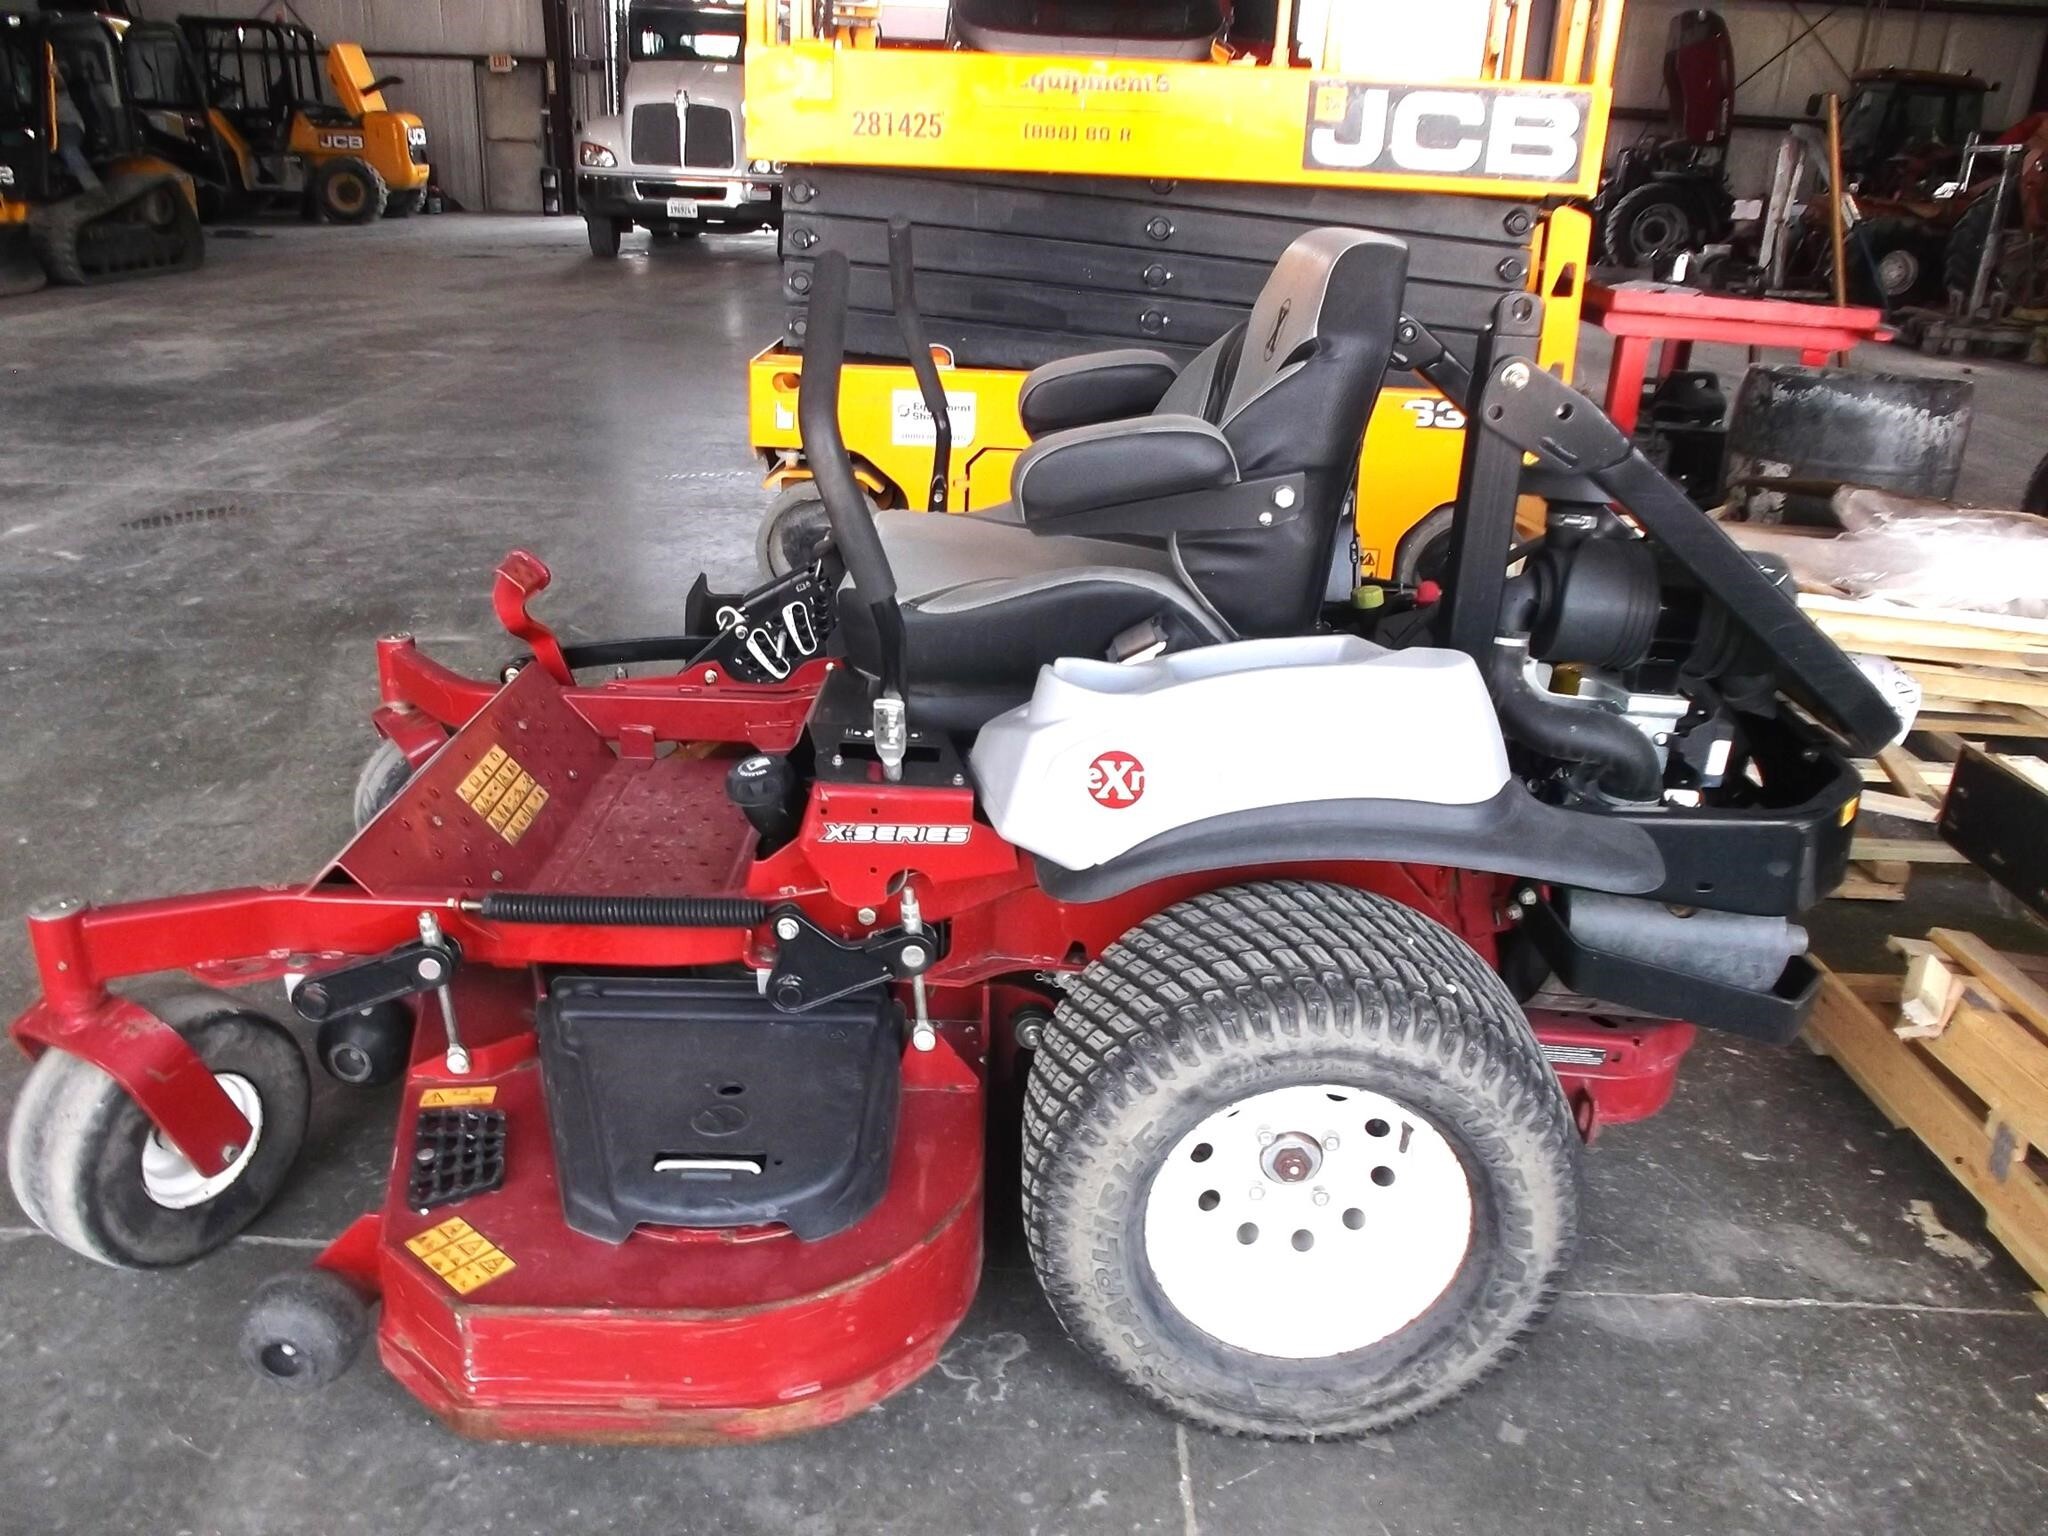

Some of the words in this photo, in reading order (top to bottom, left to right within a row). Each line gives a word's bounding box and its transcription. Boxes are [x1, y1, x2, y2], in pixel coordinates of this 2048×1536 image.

[319, 134, 364, 149] JCB
[853, 110, 942, 139] 281425
[1311, 88, 1582, 178] JCB
[1092, 1121, 1168, 1356] CARLISLE
